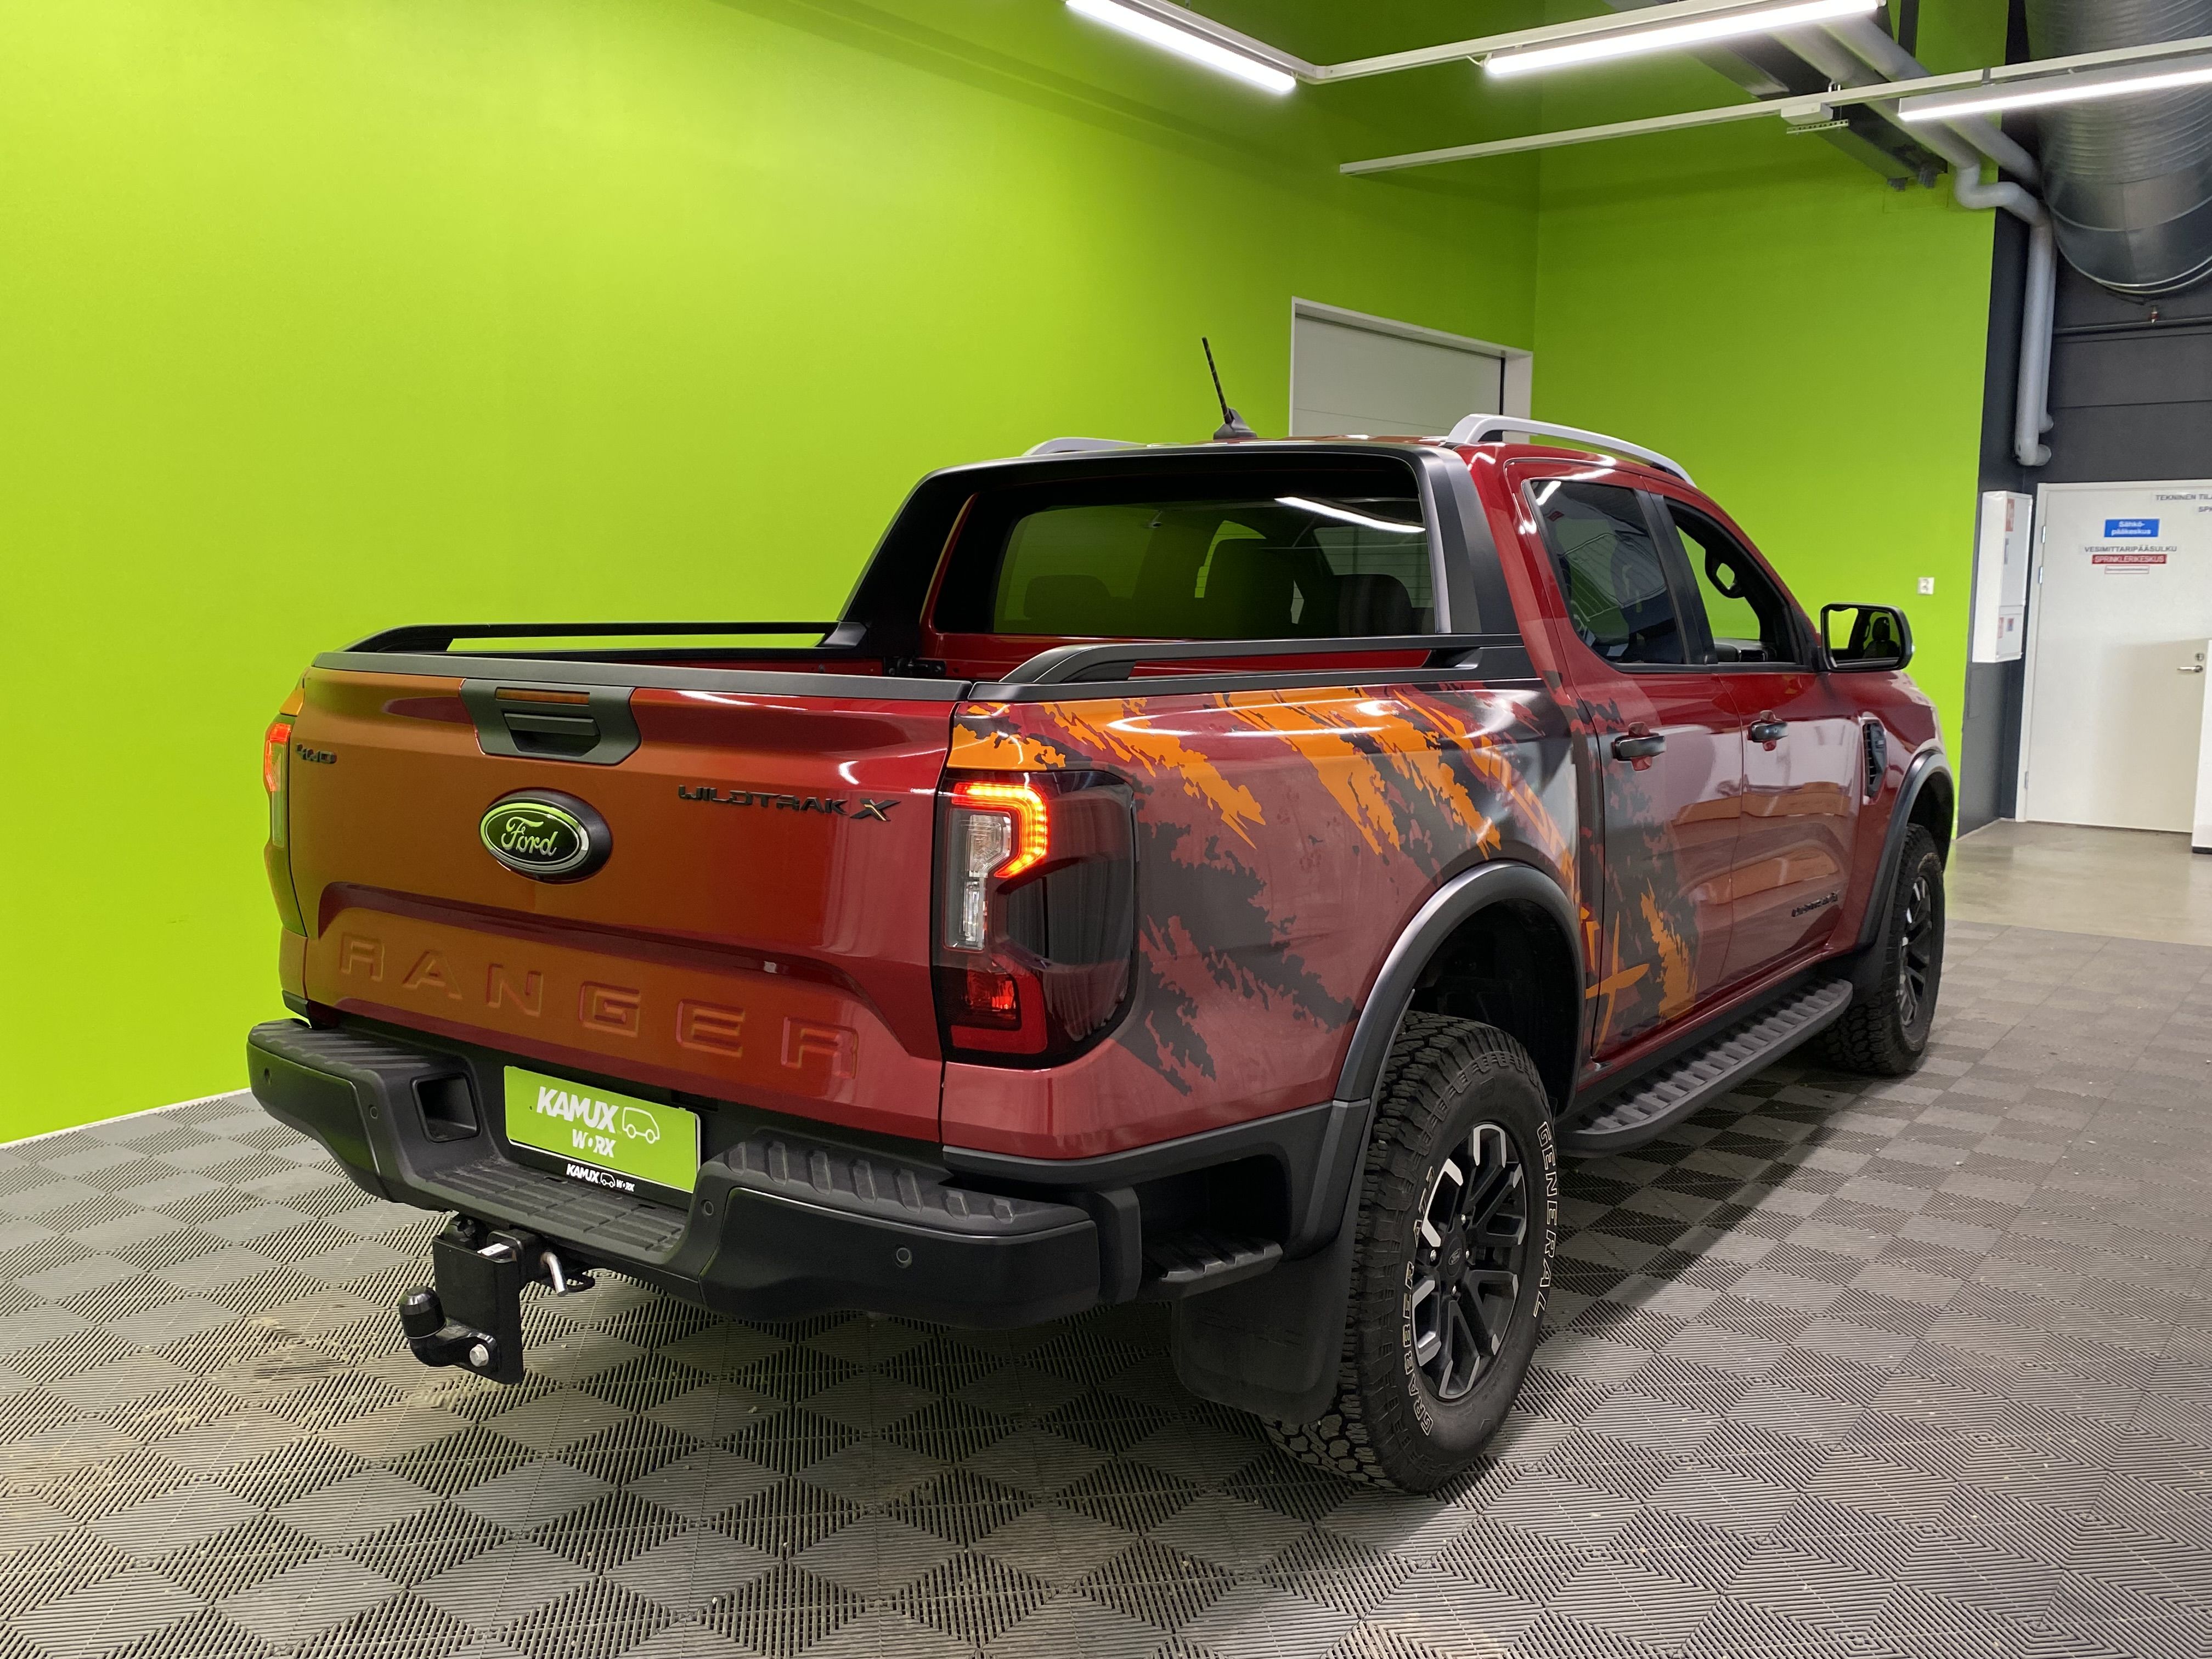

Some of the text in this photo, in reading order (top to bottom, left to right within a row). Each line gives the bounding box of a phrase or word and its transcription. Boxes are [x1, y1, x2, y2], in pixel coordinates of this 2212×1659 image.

[678, 785, 849, 816] WILDTRAK
[500, 816, 558, 857] Ford
[338, 932, 860, 1080] RANGER
[536, 1086, 619, 1134] KAMUX
[566, 1163, 600, 1184] KAMUX
[1532, 1121, 1558, 1318] GENERAL
[1402, 1261, 1434, 1436] GRABBER
